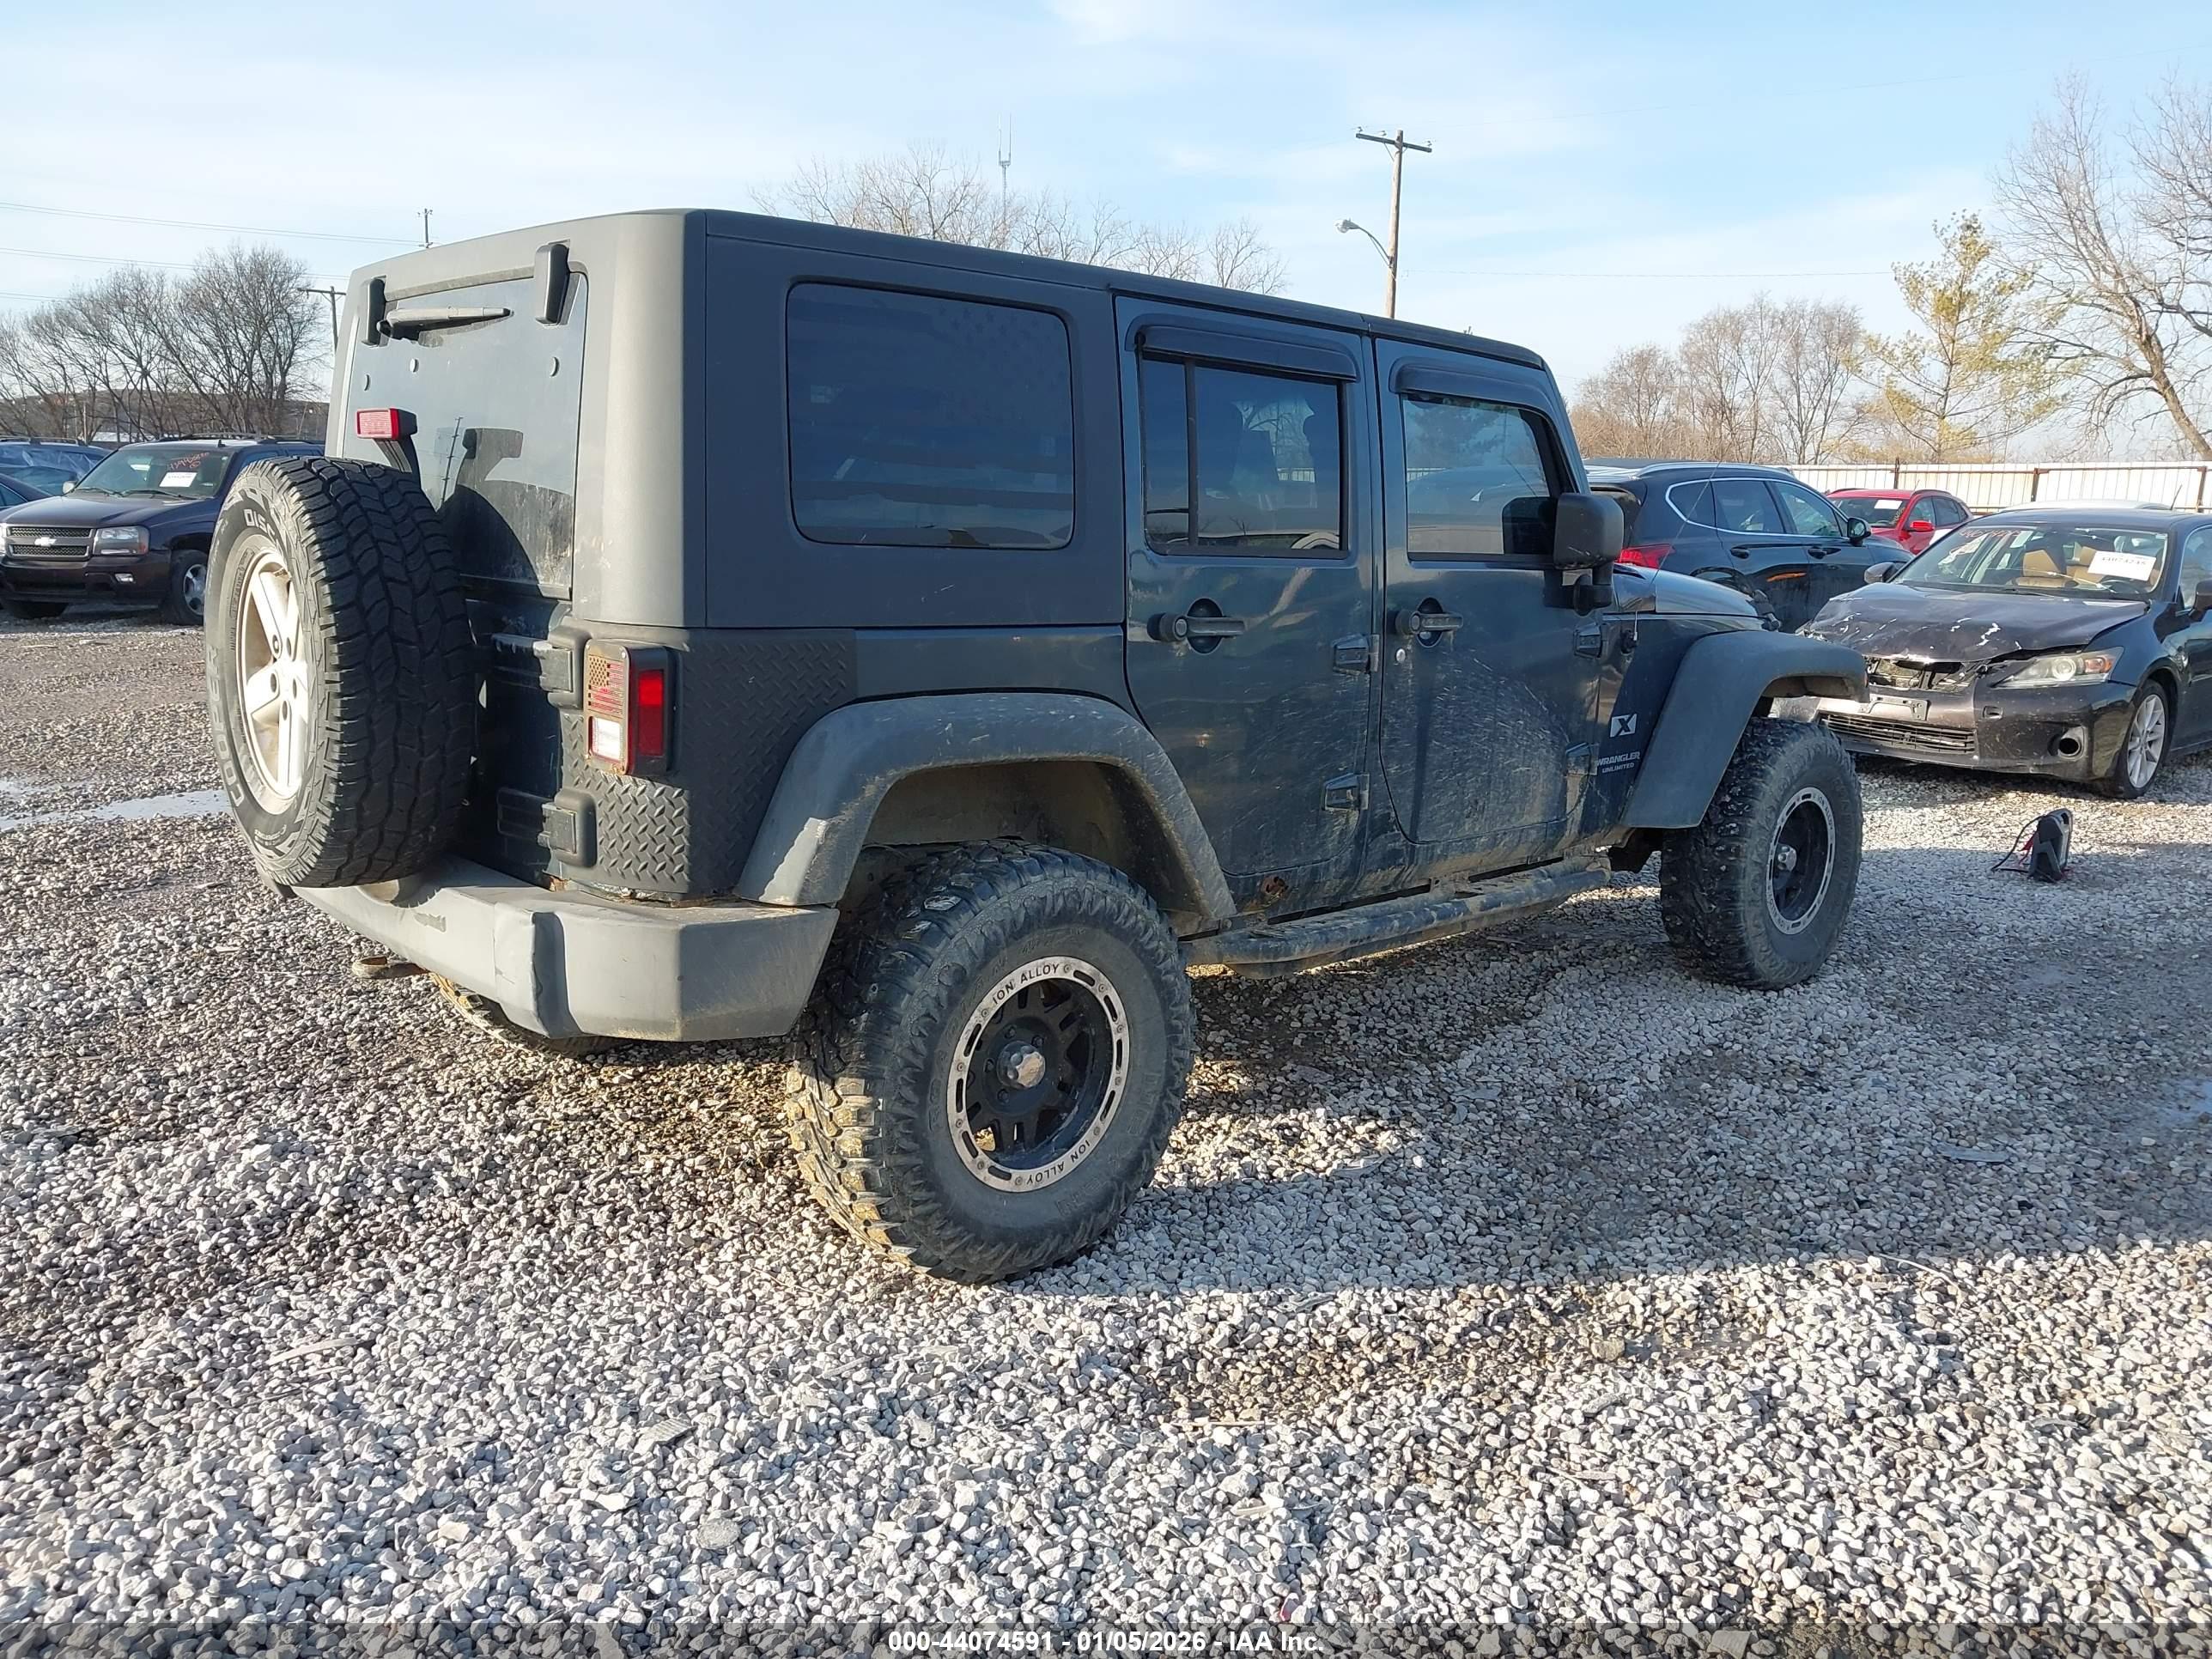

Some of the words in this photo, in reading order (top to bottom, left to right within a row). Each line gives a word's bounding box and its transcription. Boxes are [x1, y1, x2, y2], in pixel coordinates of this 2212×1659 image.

[207, 645, 245, 807] COOPER
[1597, 751, 1640, 766] WRANGLER
[1601, 762, 1635, 773] UNLIMITED
[992, 981, 1015, 1005] ION
[1019, 963, 1060, 984] ALLOY
[1071, 1139, 1091, 1164] ION
[1026, 1163, 1066, 1184] ALLOY
